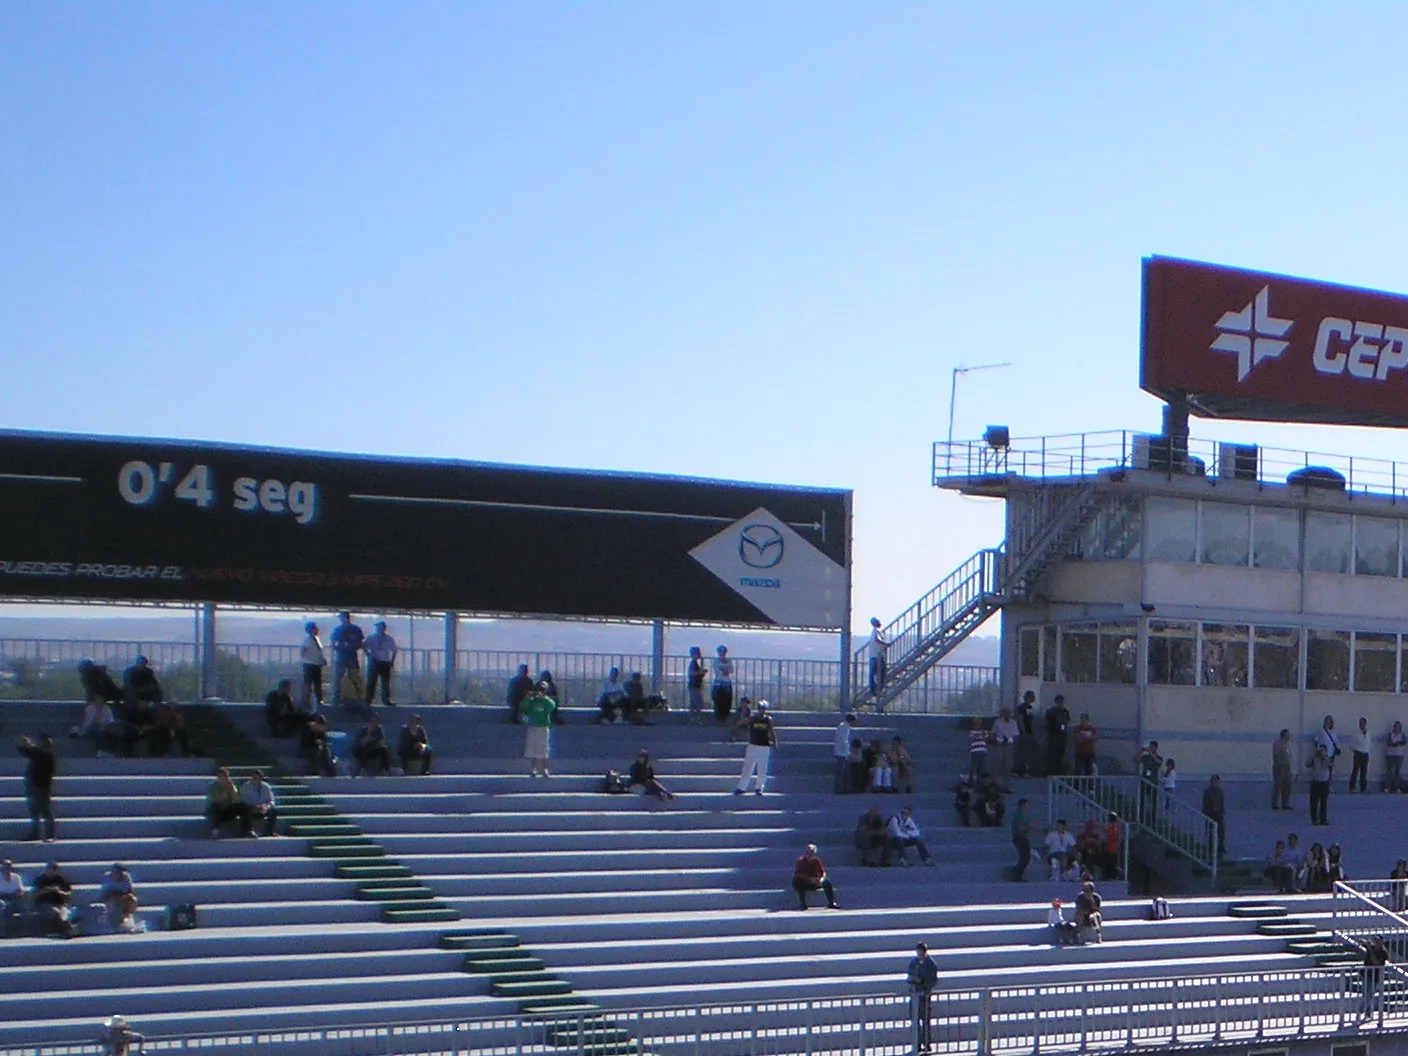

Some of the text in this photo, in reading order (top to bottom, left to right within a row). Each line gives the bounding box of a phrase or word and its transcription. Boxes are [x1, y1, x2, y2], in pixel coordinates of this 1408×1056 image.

[118, 461, 315, 524] 0'4 seg
[75, 563, 158, 578] PROBAR
[160, 565, 184, 580] EL
